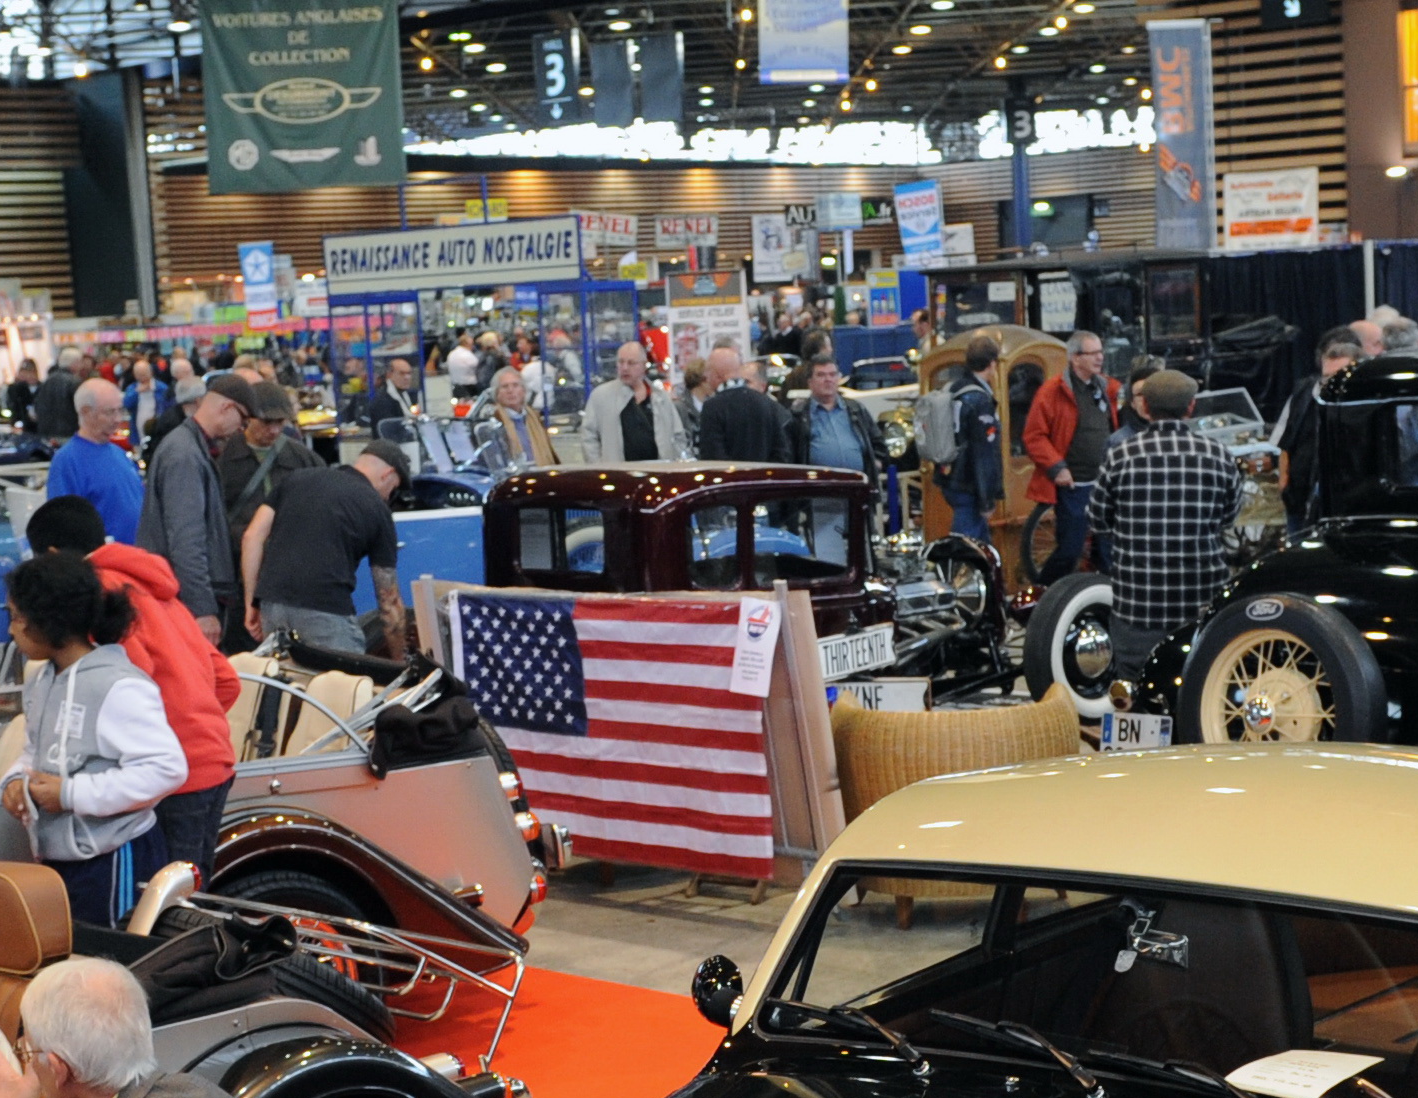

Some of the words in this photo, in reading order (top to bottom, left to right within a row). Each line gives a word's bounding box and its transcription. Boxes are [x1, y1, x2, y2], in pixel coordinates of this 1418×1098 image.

[211, 13, 292, 29] VOITURES
[294, 7, 383, 25] ANGLAISES
[247, 47, 351, 66] COLLECTION
[544, 53, 567, 98] 3
[1013, 110, 1032, 140] 3
[330, 242, 431, 277] RENAISSANCE
[437, 238, 477, 267] AUTO
[482, 230, 572, 264] NOSTALGIE
[823, 632, 887, 676] THIRTEENTH
[1118, 718, 1141, 744] BN
